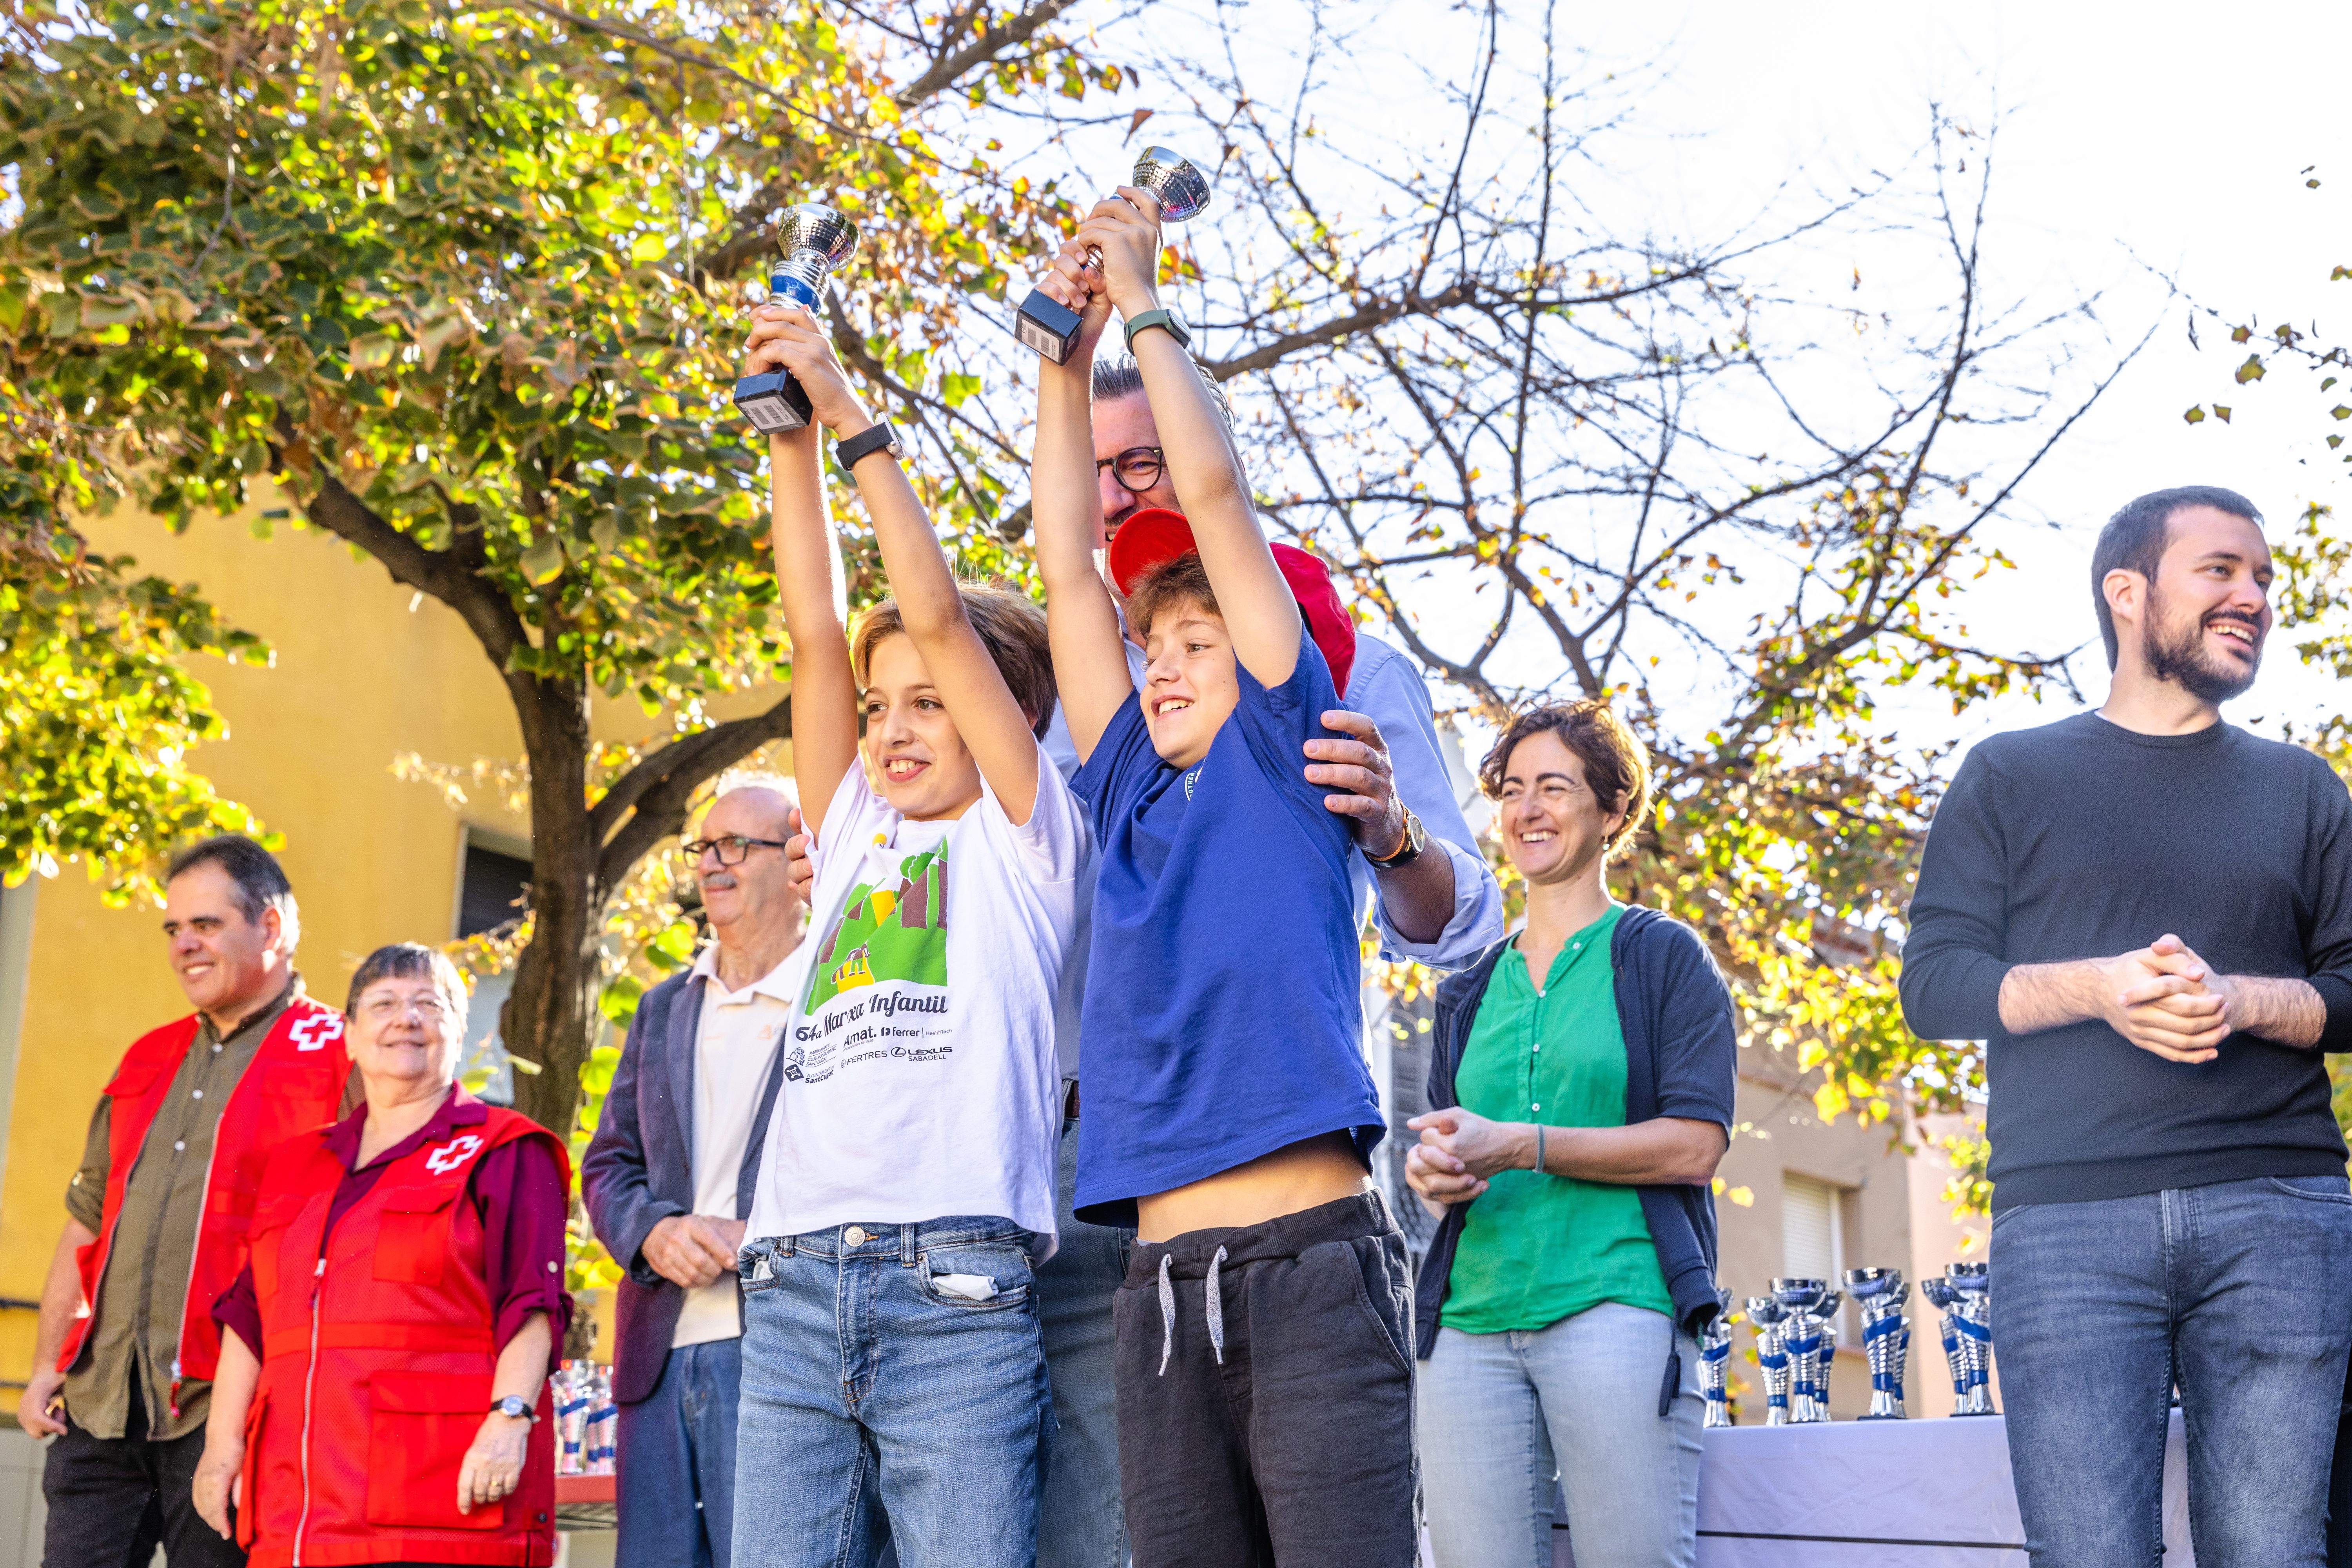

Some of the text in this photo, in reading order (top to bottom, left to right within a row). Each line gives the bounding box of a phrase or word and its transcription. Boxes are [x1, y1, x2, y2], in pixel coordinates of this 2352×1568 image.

[795, 1024, 822, 1042] 64a
[824, 1003, 864, 1037] Marxa
[869, 991, 948, 1017] Infantil
[843, 1026, 877, 1049] Amat.
[893, 1027, 920, 1037] ferrer
[847, 1047, 953, 1065] FERTRES LEXUS
[908, 1053, 947, 1062] SABADELL
